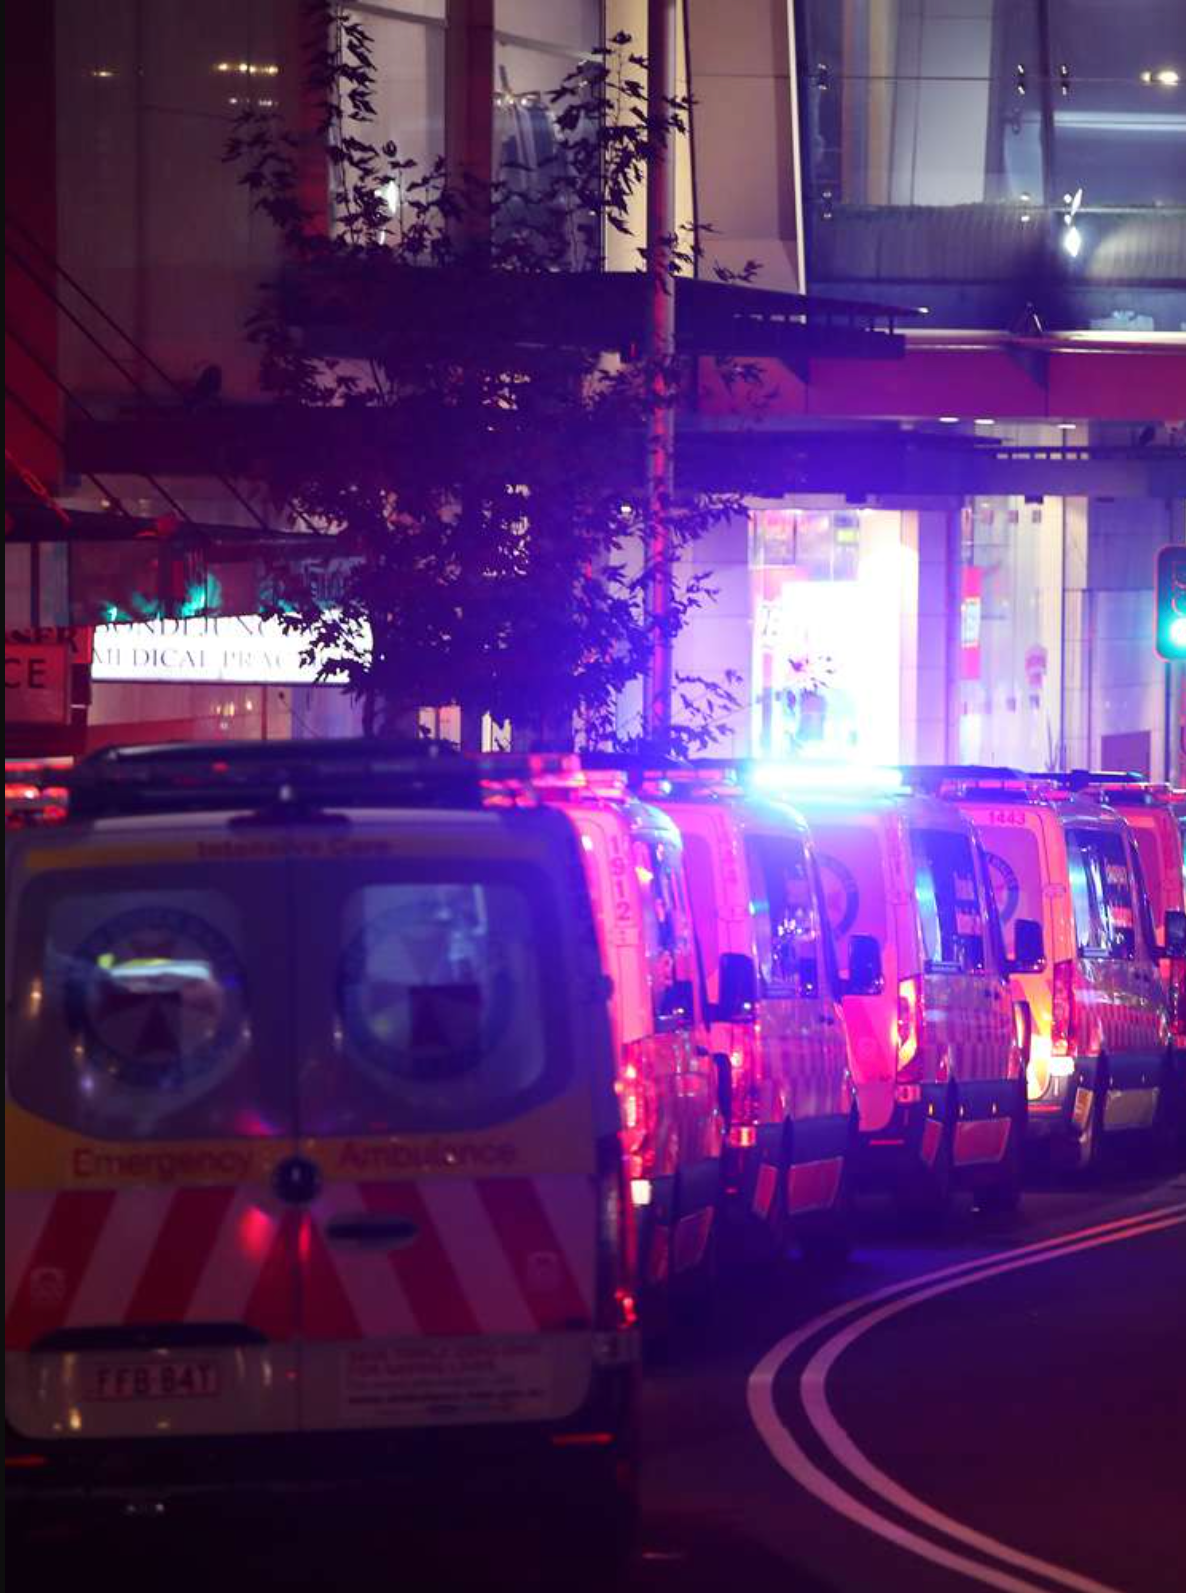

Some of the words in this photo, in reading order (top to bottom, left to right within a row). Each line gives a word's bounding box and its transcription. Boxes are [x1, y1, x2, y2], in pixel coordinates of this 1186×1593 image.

[989, 811, 1026, 825] 1443
[73, 1147, 252, 1182] Emergency
[339, 1139, 516, 1169] Ambulance
